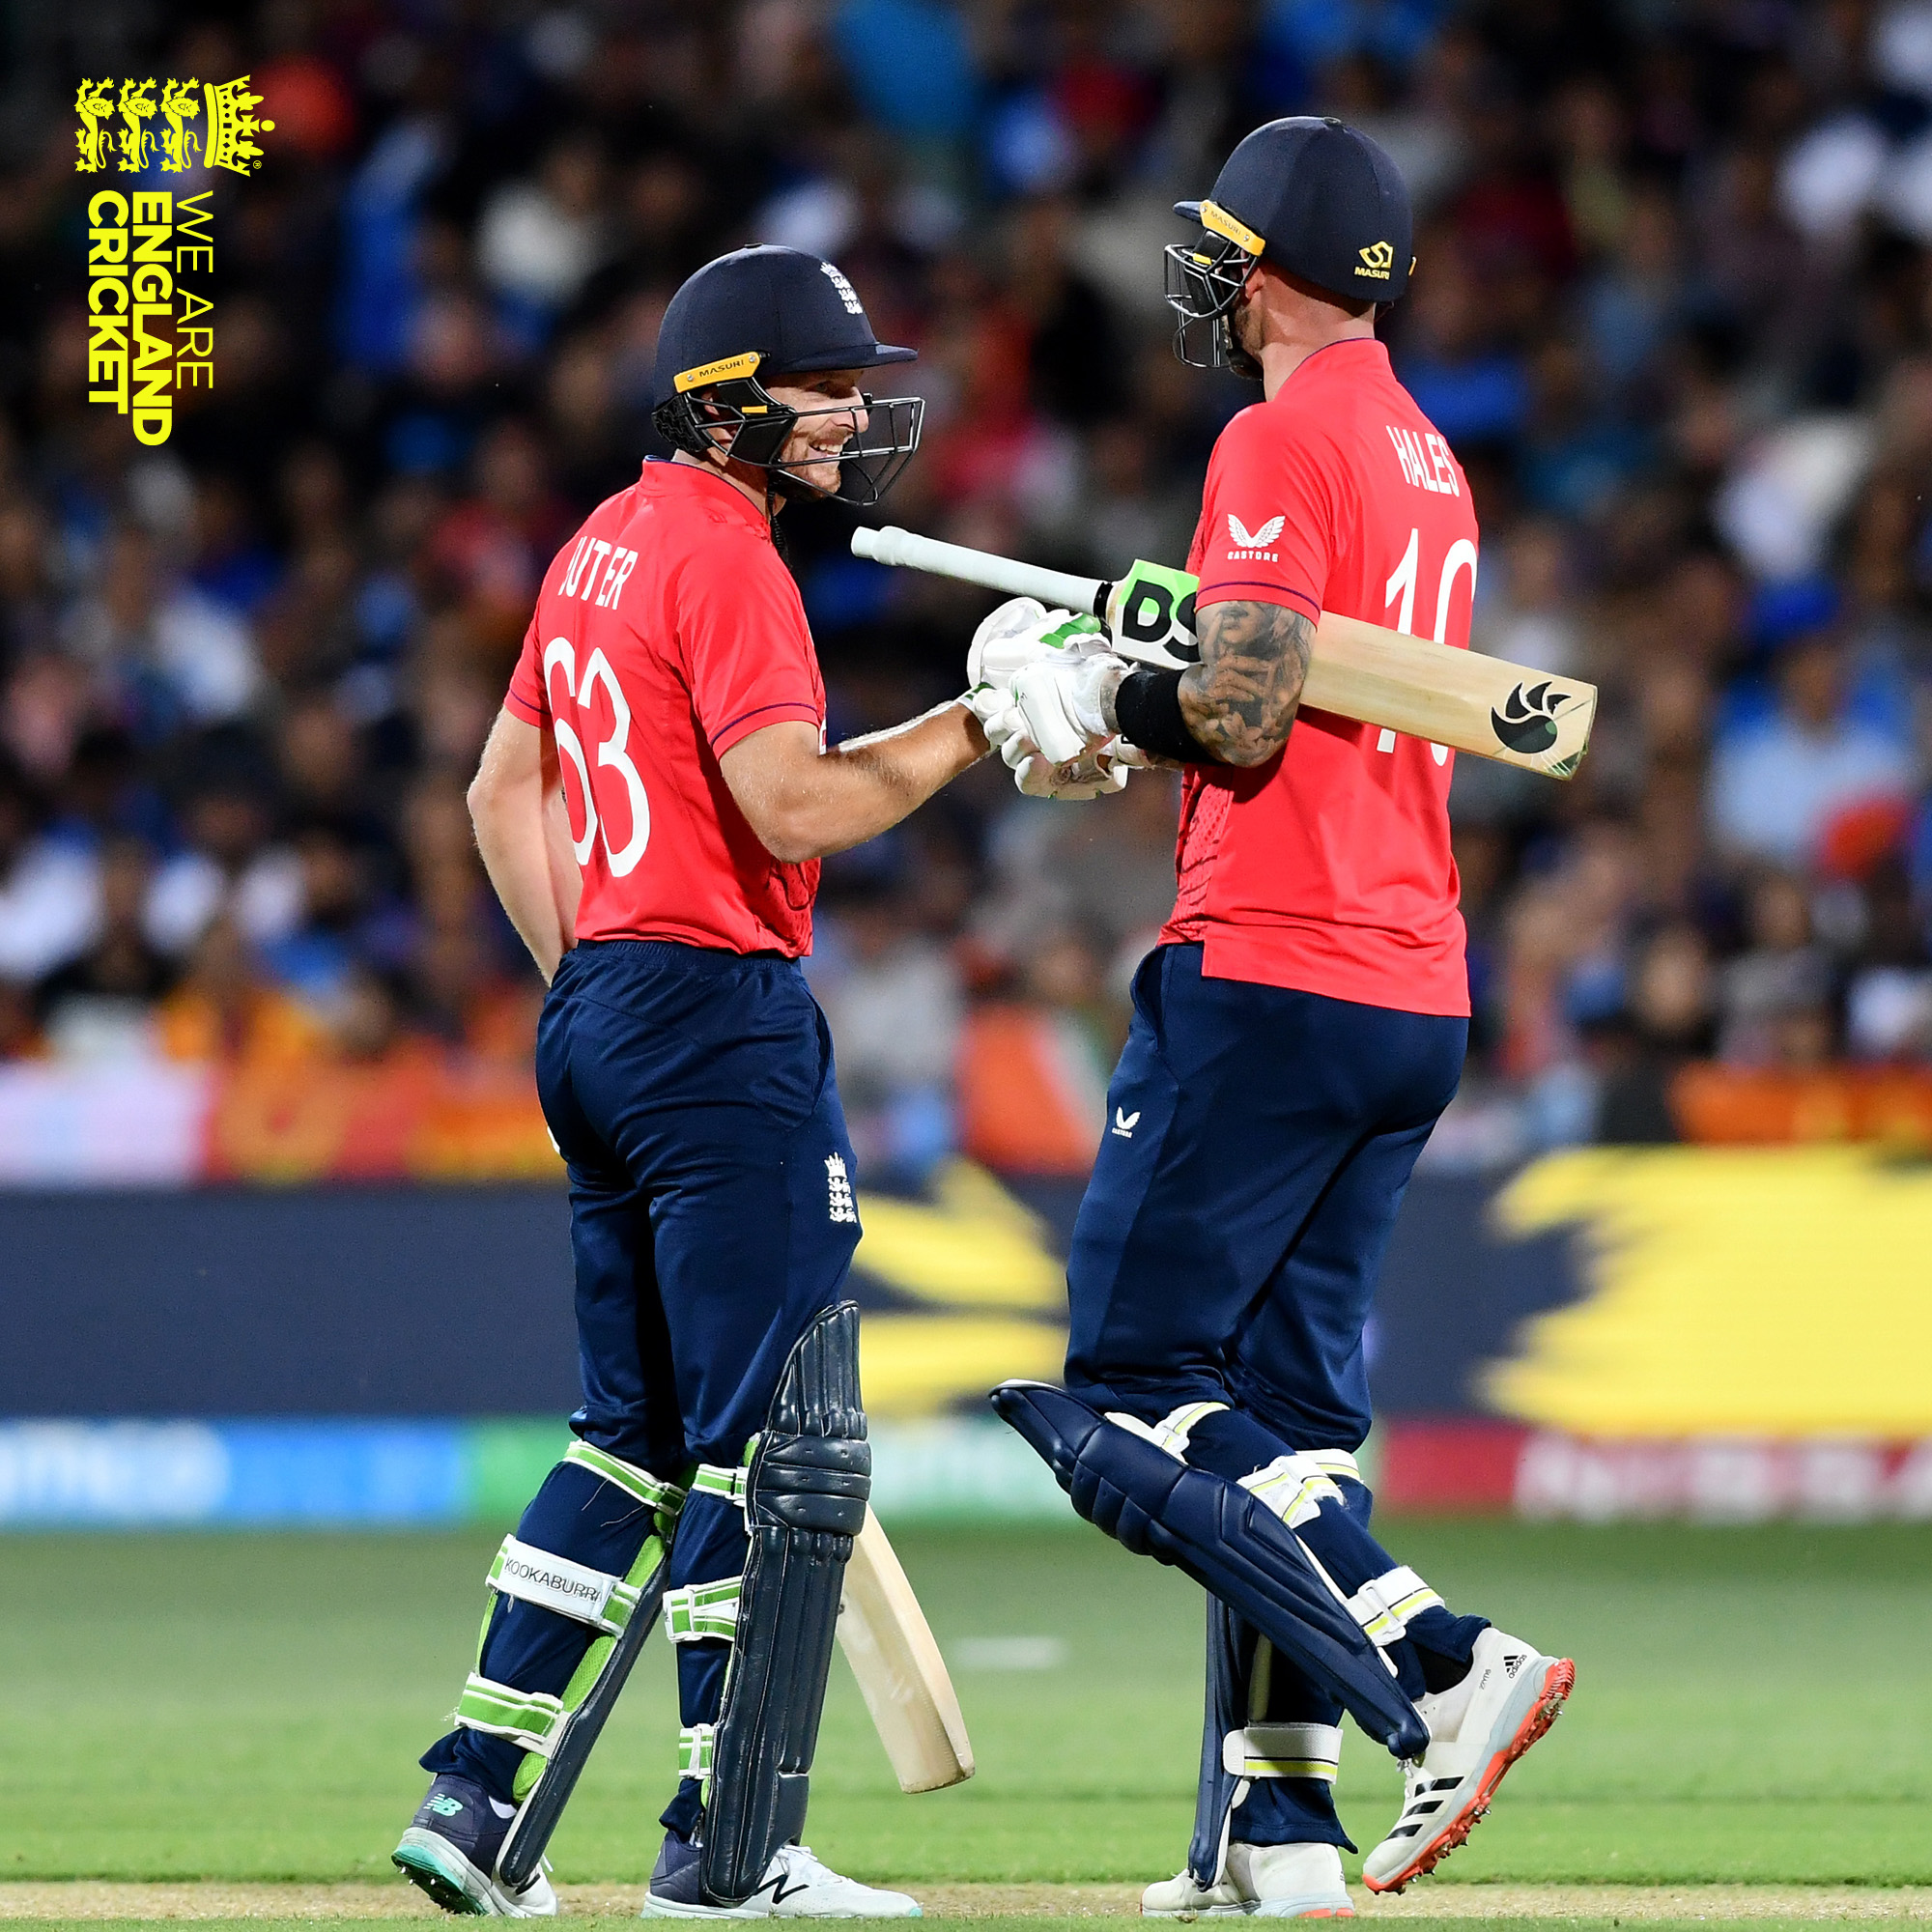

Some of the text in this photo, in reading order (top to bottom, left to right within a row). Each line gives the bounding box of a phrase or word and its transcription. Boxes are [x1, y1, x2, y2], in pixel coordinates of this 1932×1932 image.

[1210, 210, 1241, 236] MASURI
[1353, 266, 1390, 280] MASURI
[698, 358, 745, 378] MASURI
[1385, 424, 1461, 497] HALES
[1227, 550, 1279, 563] CASTORE
[543, 636, 651, 878] 63
[1508, 1654, 1528, 1679] adidas
